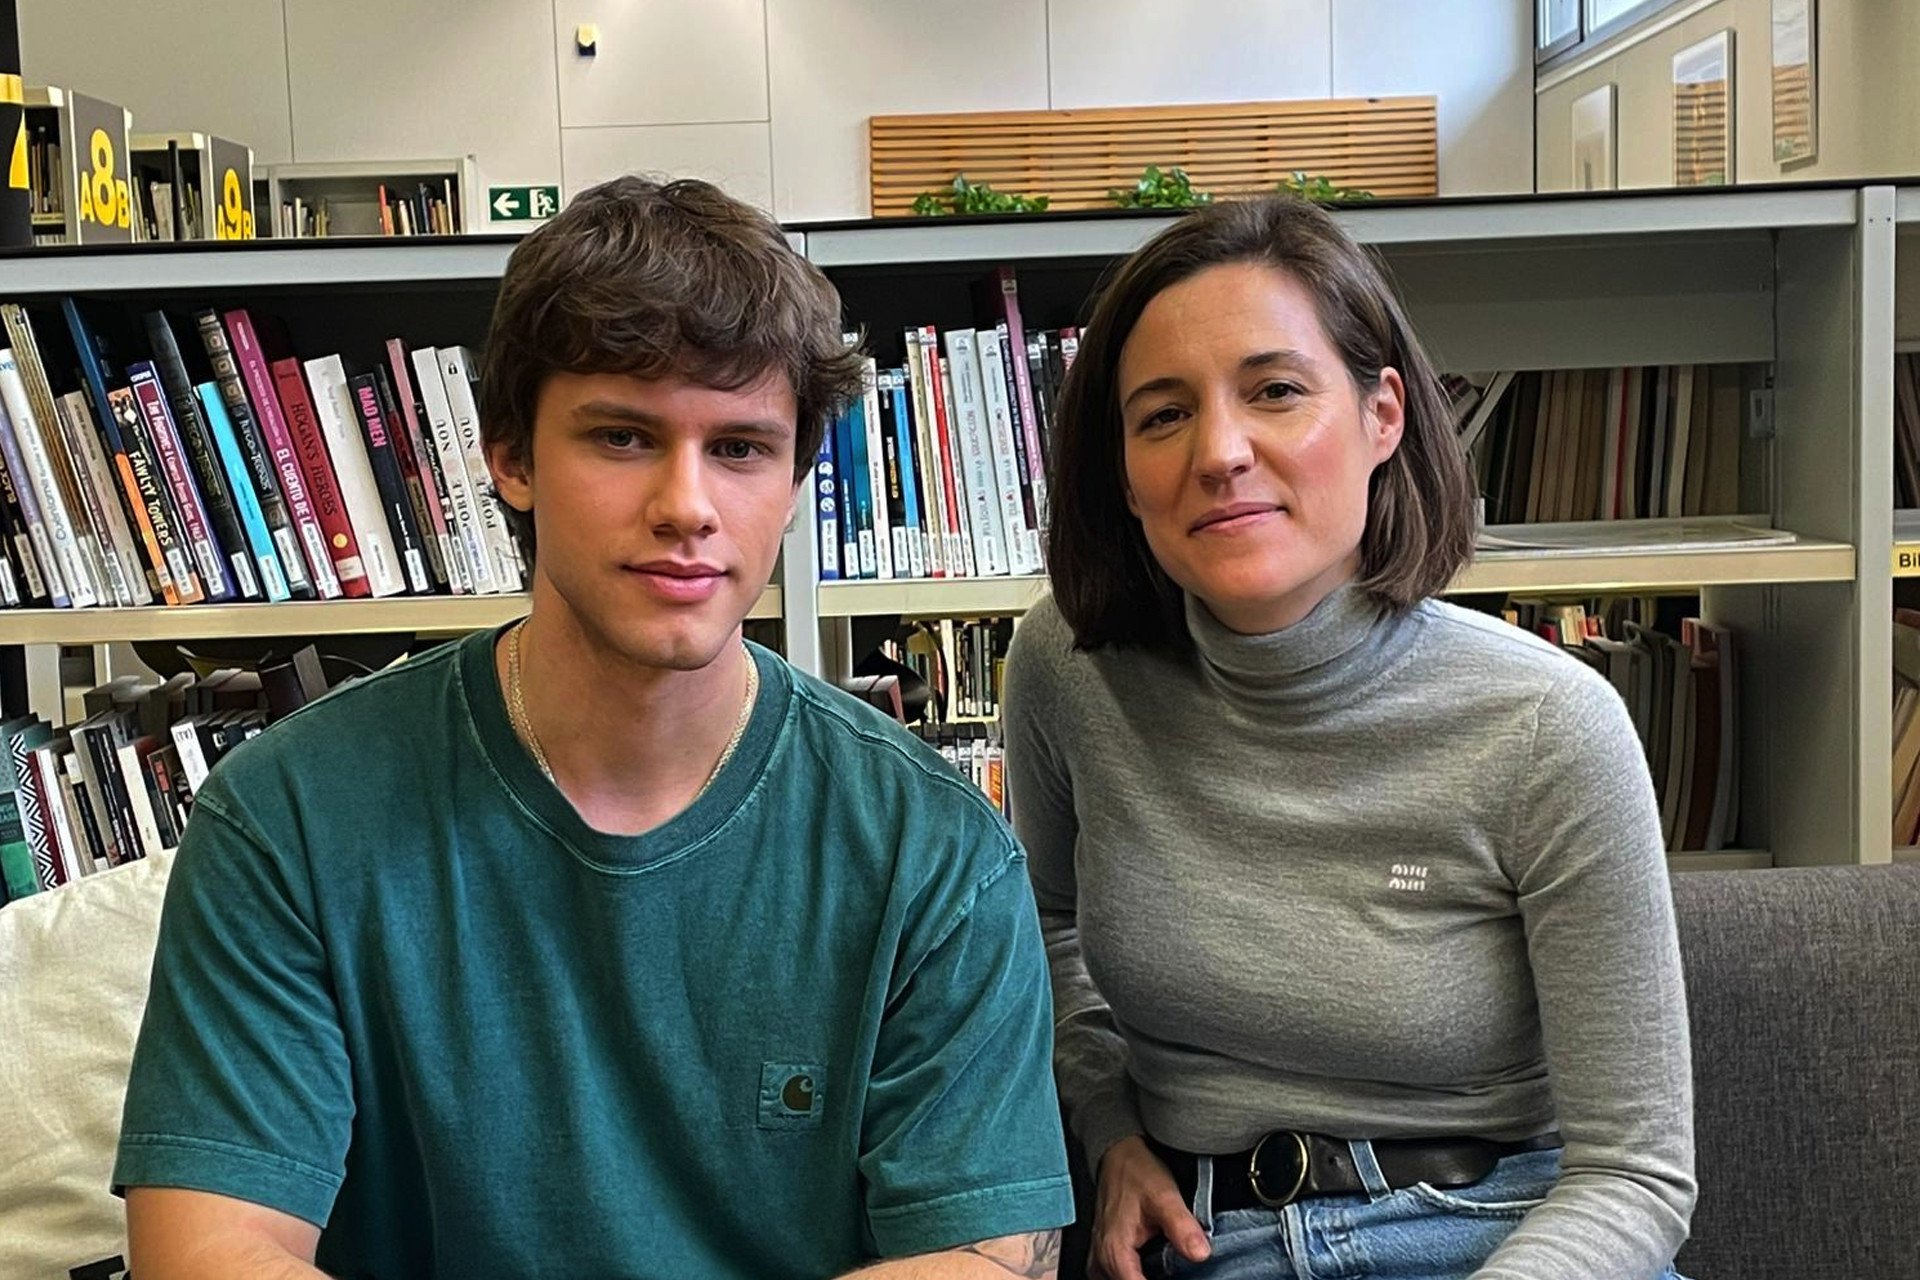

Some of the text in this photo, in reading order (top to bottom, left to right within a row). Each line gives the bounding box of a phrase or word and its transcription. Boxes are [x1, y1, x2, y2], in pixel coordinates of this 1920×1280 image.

[358, 386, 387, 448] MAD MEN
[276, 448, 291, 463] EL
[291, 402, 320, 461] HOGAN'S
[311, 464, 338, 516] HEROES
[129, 450, 174, 547] FAWLTY TOWERS
[281, 462, 305, 502] CUENTO
[294, 501, 311, 518] DE
